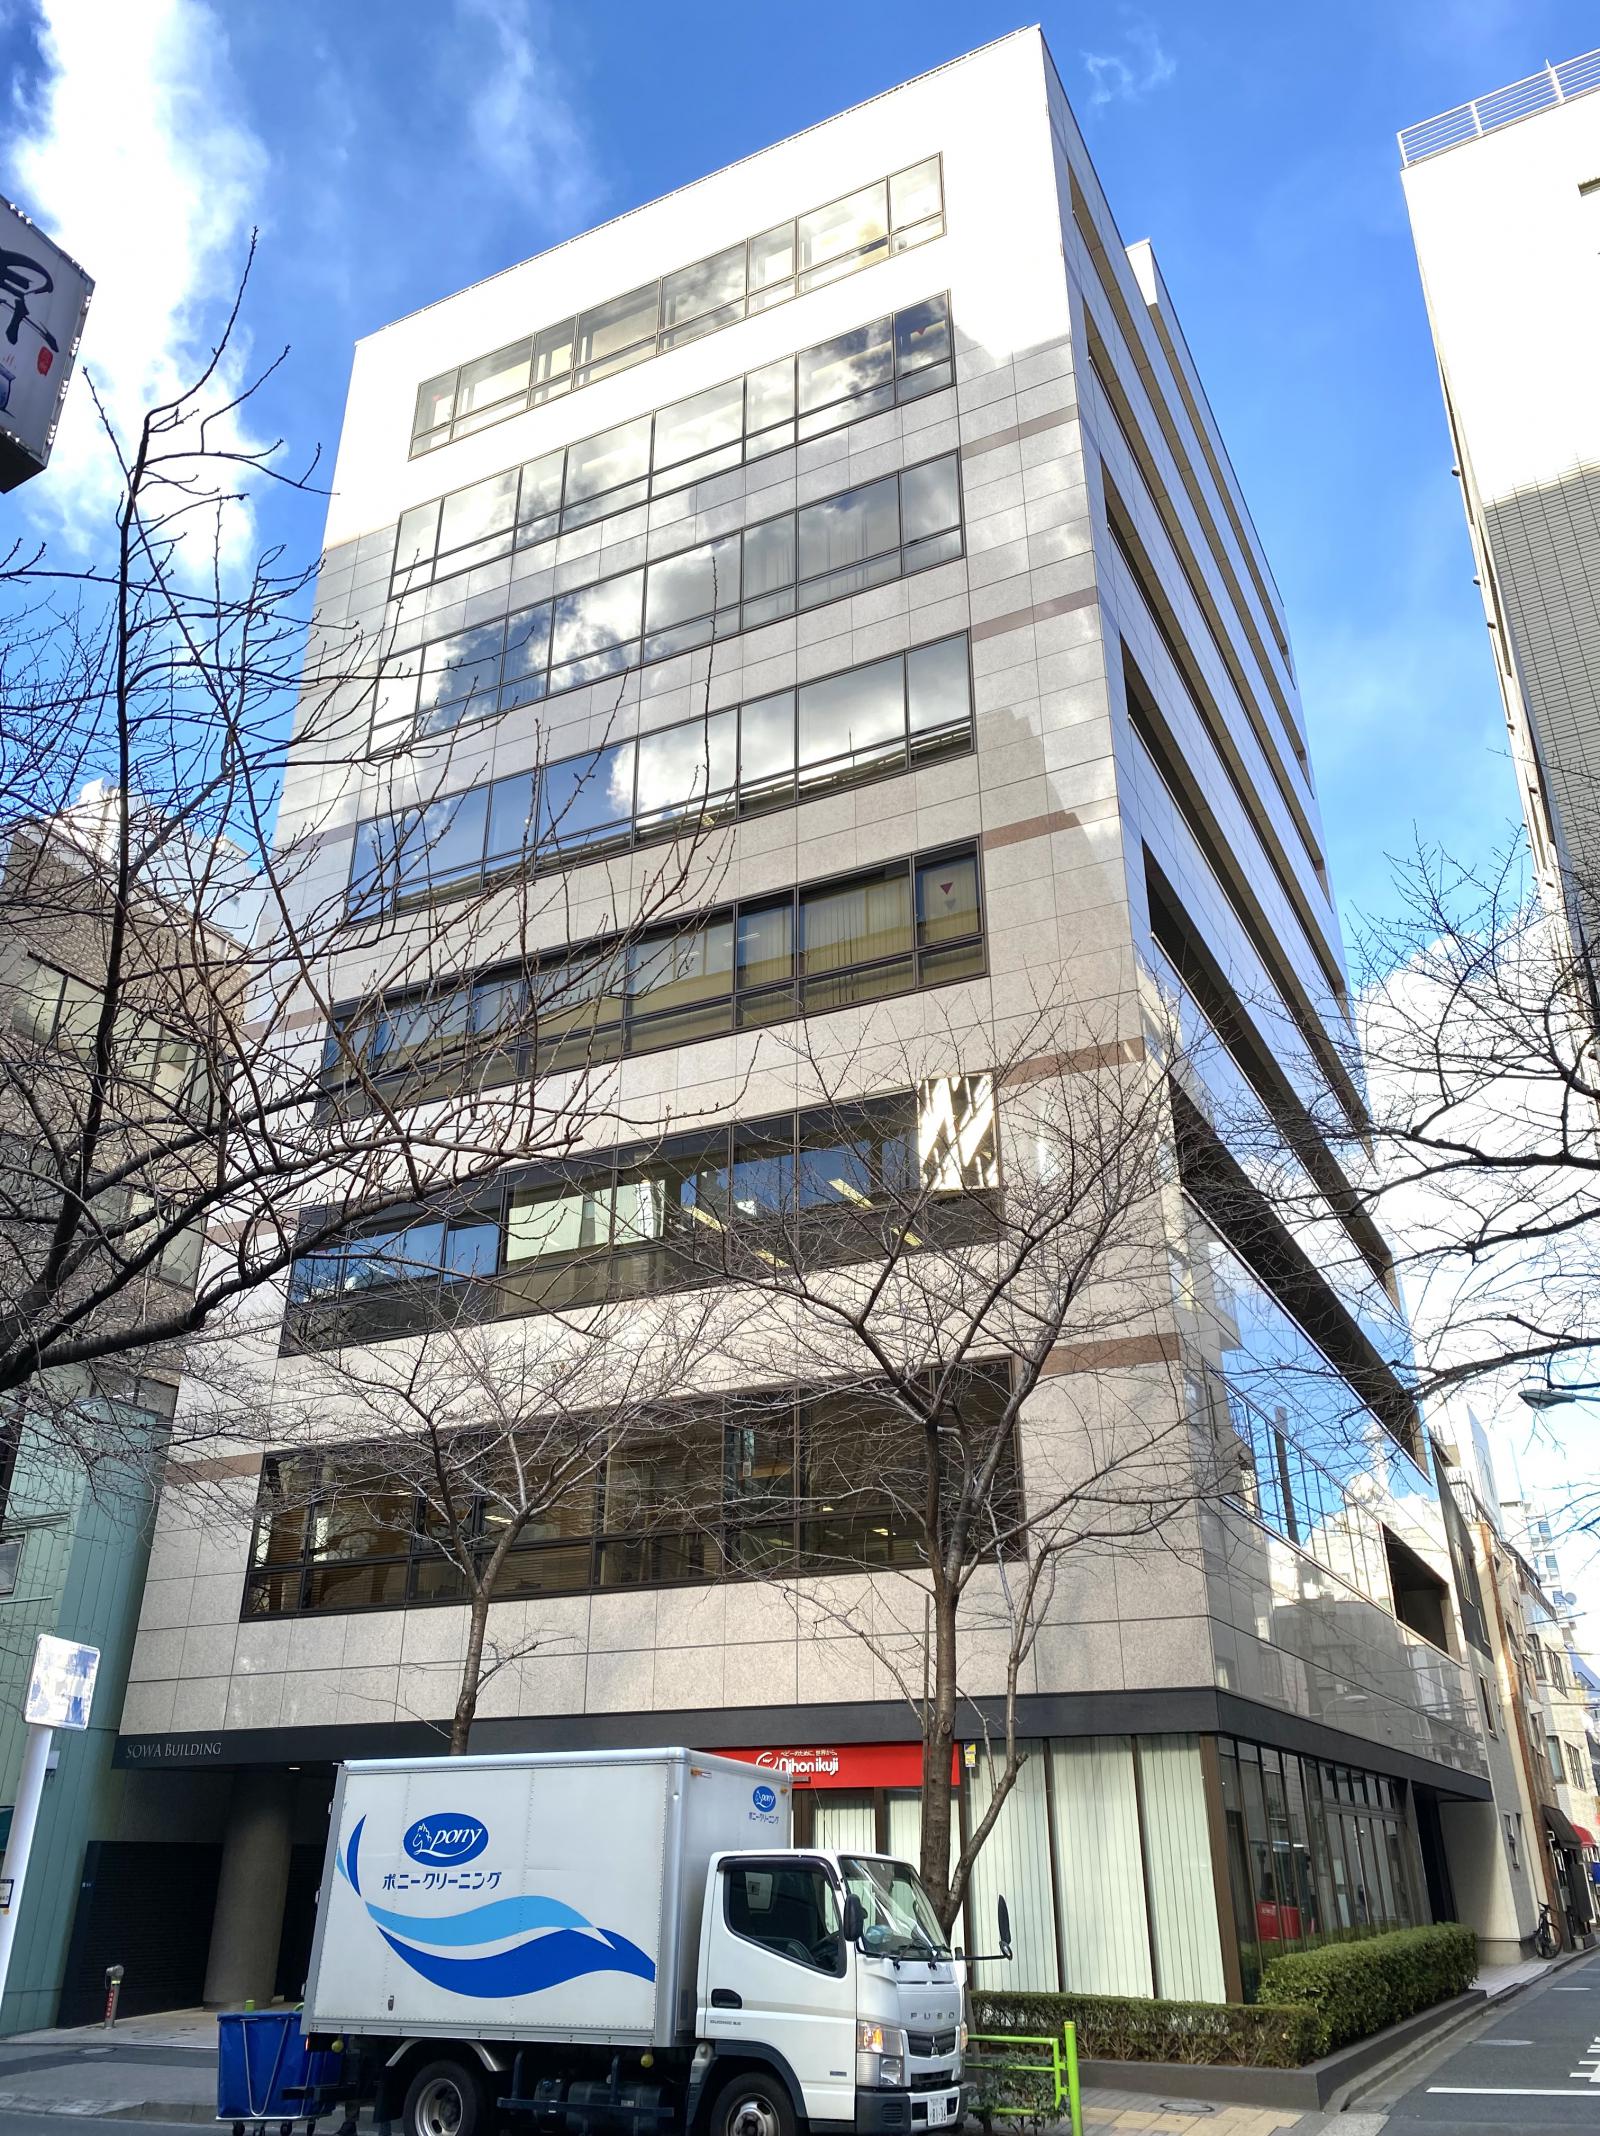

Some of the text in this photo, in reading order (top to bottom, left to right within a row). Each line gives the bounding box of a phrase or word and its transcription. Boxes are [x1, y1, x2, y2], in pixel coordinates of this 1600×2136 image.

[126, 1742, 222, 1759] SOWA BUILDING
[815, 1757, 839, 1776] ikuji
[424, 1827, 483, 1858] pony
[382, 1871, 502, 1890] ポニークリーニング
